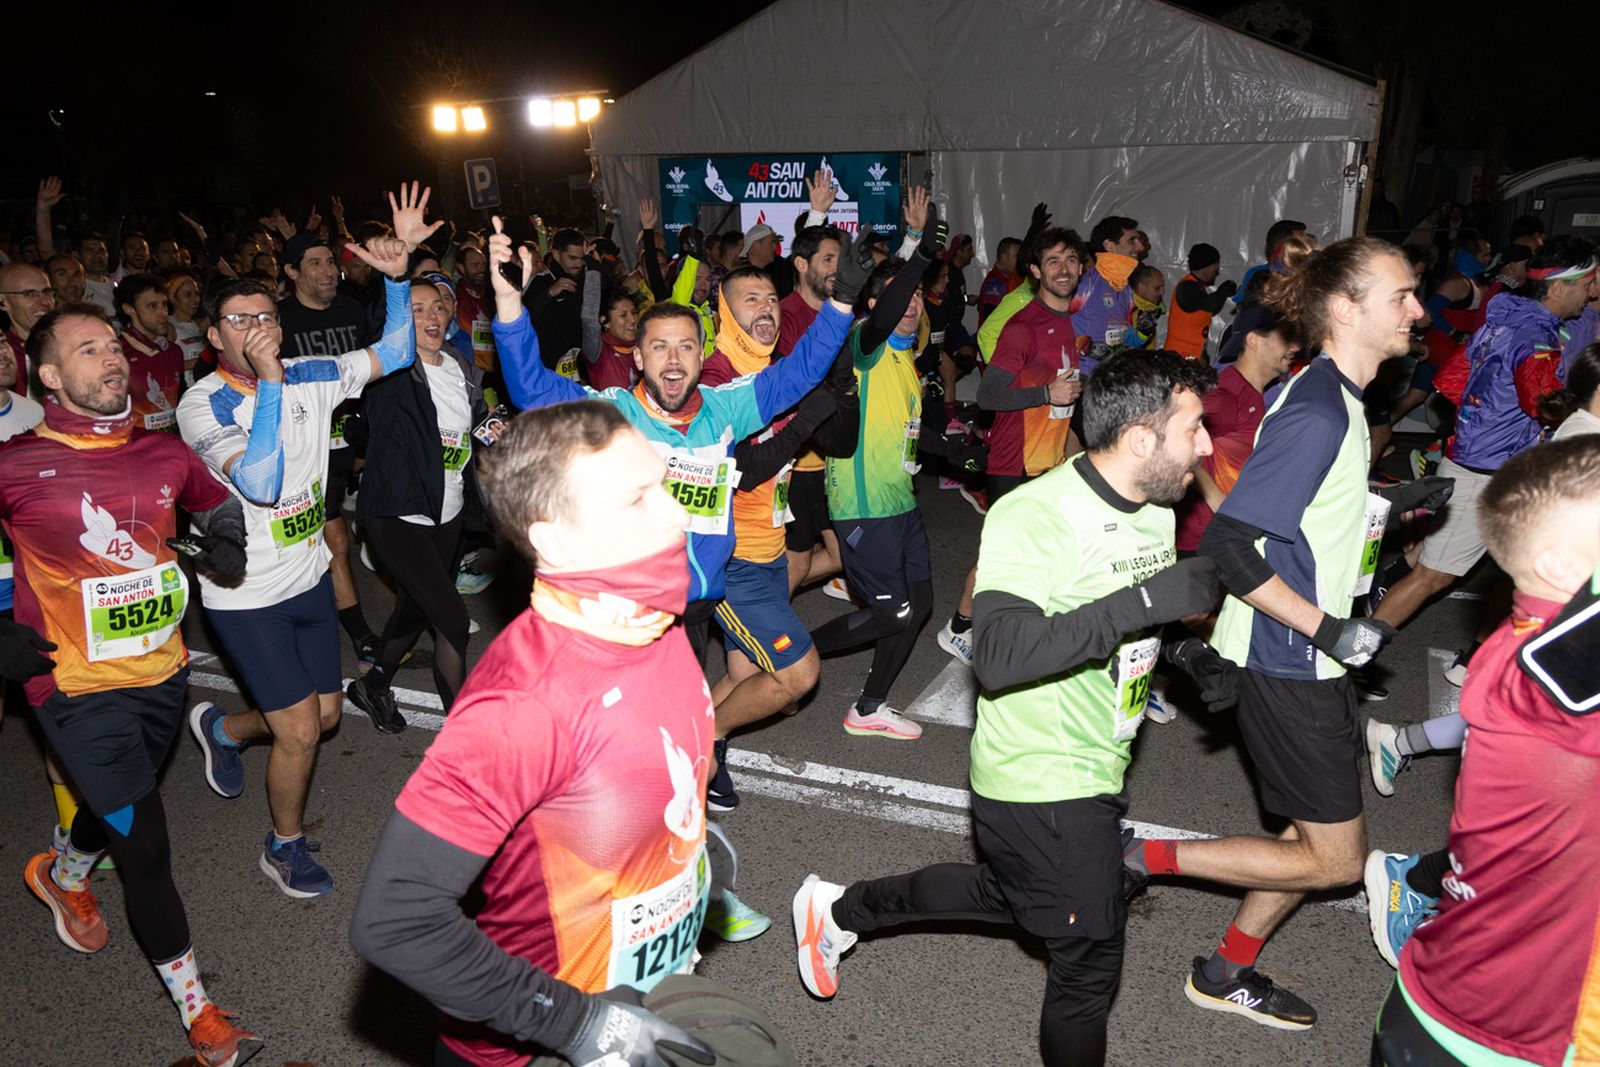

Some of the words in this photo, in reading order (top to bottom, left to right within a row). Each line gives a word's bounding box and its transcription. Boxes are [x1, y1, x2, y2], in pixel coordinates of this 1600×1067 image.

[472, 165, 491, 192] P
[748, 162, 769, 181] 43
[770, 162, 806, 179] SAN
[744, 176, 803, 199] ANTÓN
[666, 469, 684, 480] SAN
[678, 463, 704, 475] NOCHE
[671, 482, 718, 509] 1556
[273, 508, 290, 519] SAN
[282, 502, 323, 538] 5523
[106, 538, 134, 561] 43
[1110, 559, 1129, 574] XIII
[1129, 553, 1160, 570] LEGUA
[110, 580, 141, 595] NOCHE
[142, 578, 153, 588] DE
[98, 596, 120, 608] SAN
[108, 593, 174, 631] 5524
[1389, 879, 1401, 912] HOKA
[629, 923, 656, 944] SAN
